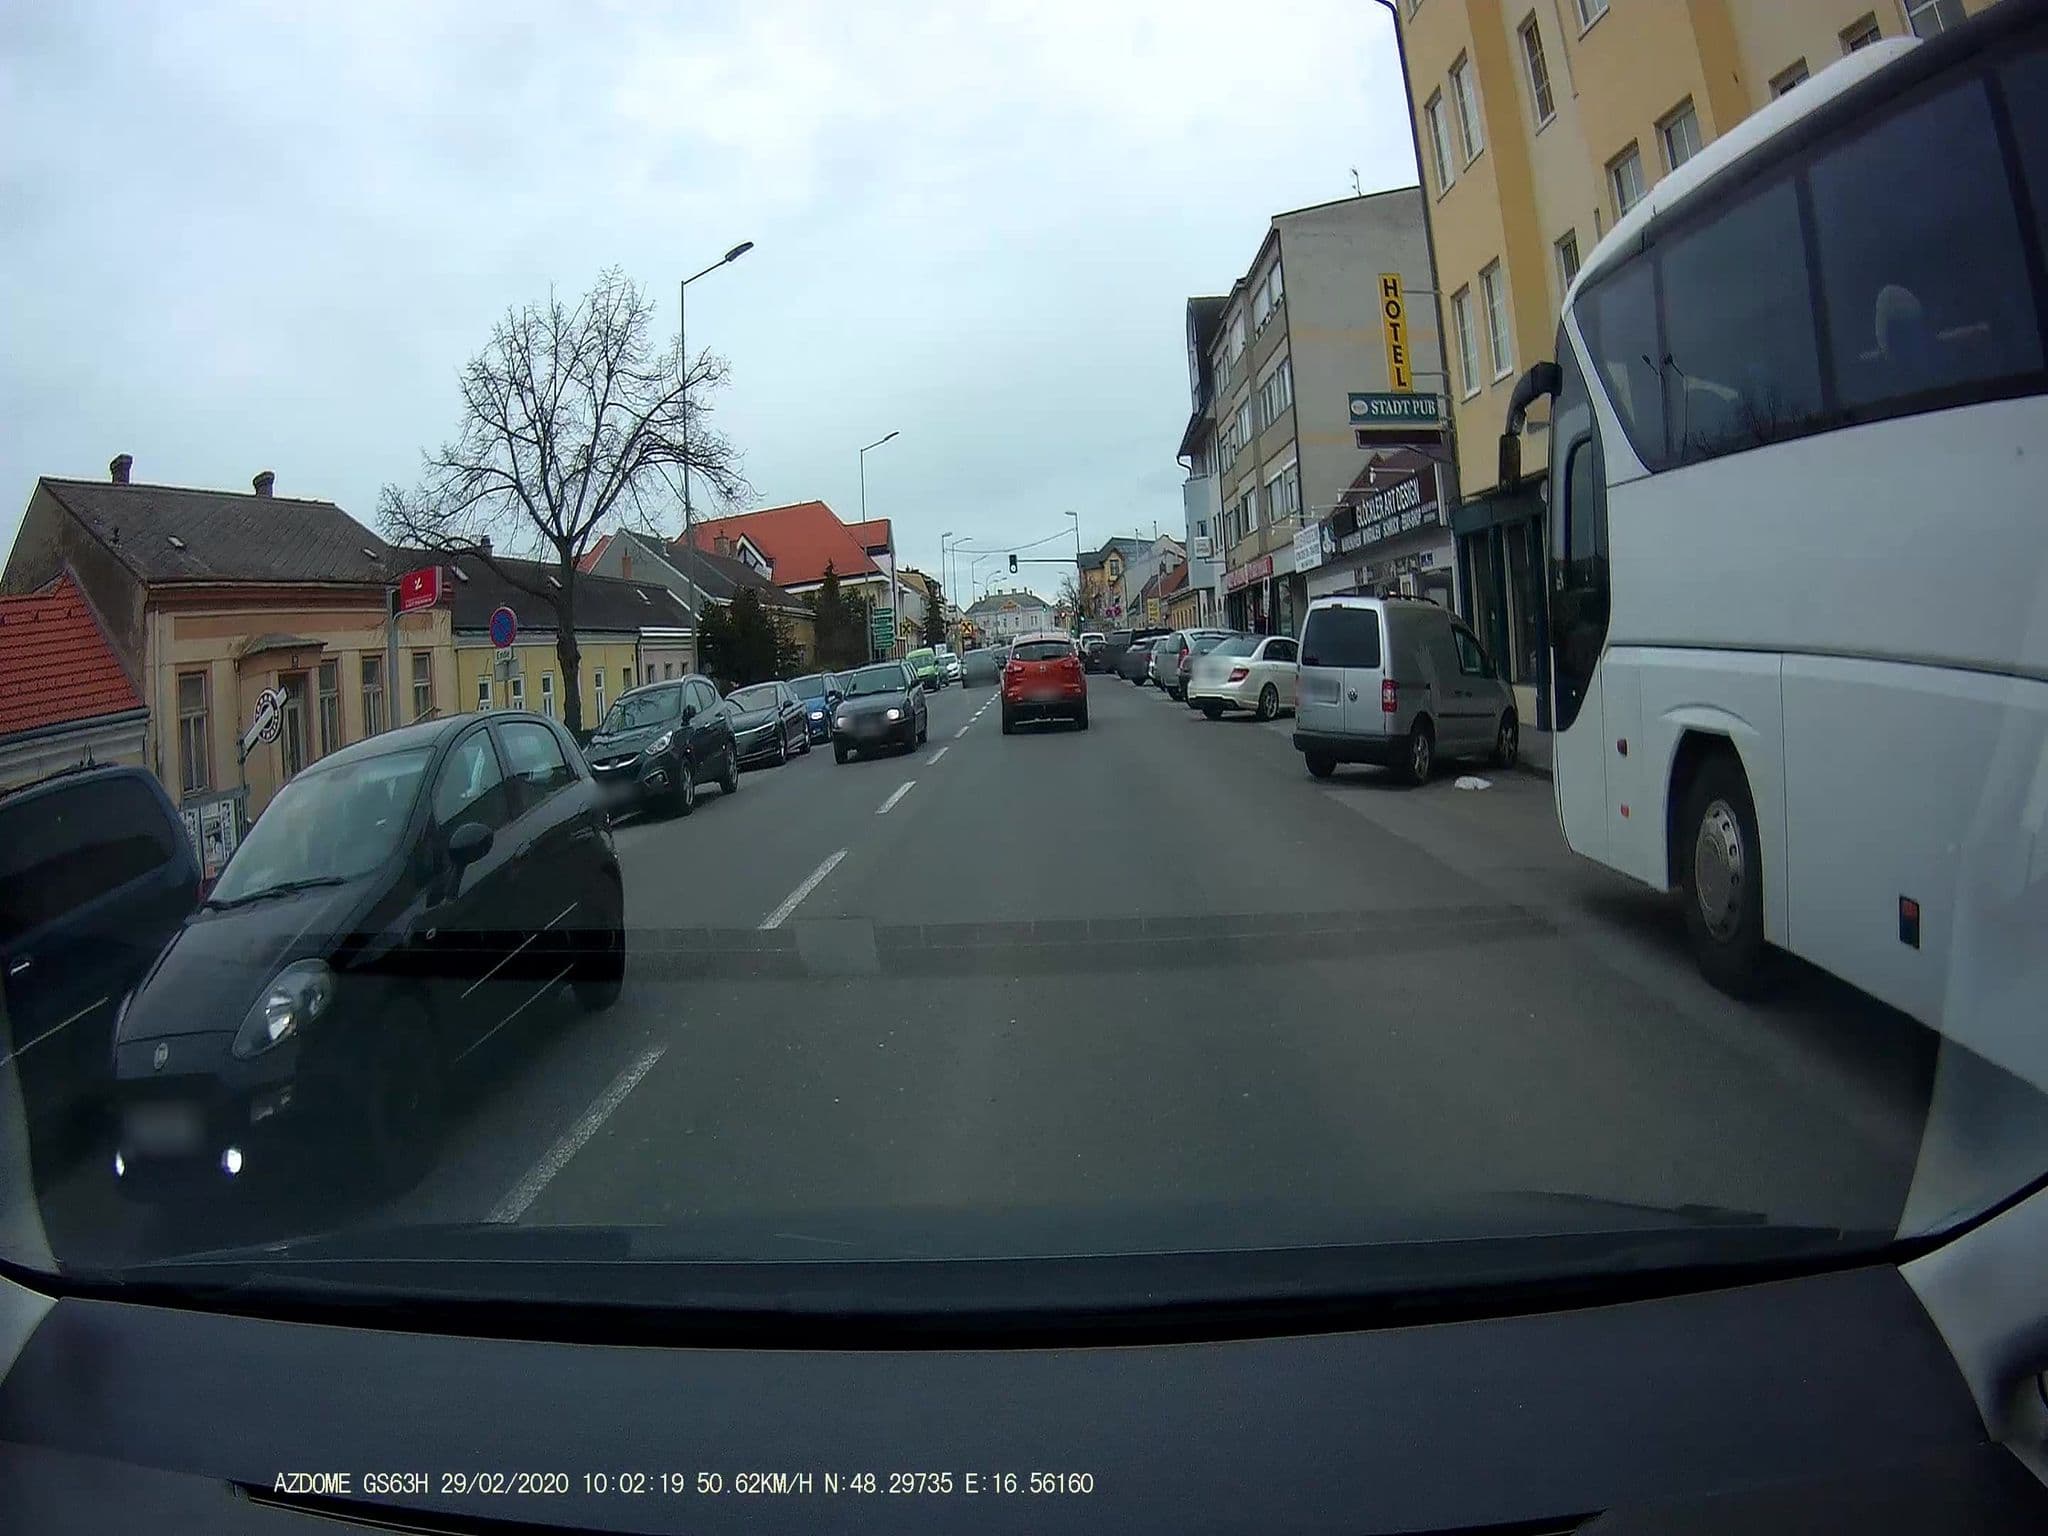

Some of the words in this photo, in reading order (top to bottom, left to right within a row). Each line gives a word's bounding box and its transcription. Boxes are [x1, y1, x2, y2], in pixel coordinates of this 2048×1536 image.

[1383, 278, 1407, 387] HOTEL
[1371, 399, 1410, 415] STADT
[1412, 399, 1436, 415] PUB
